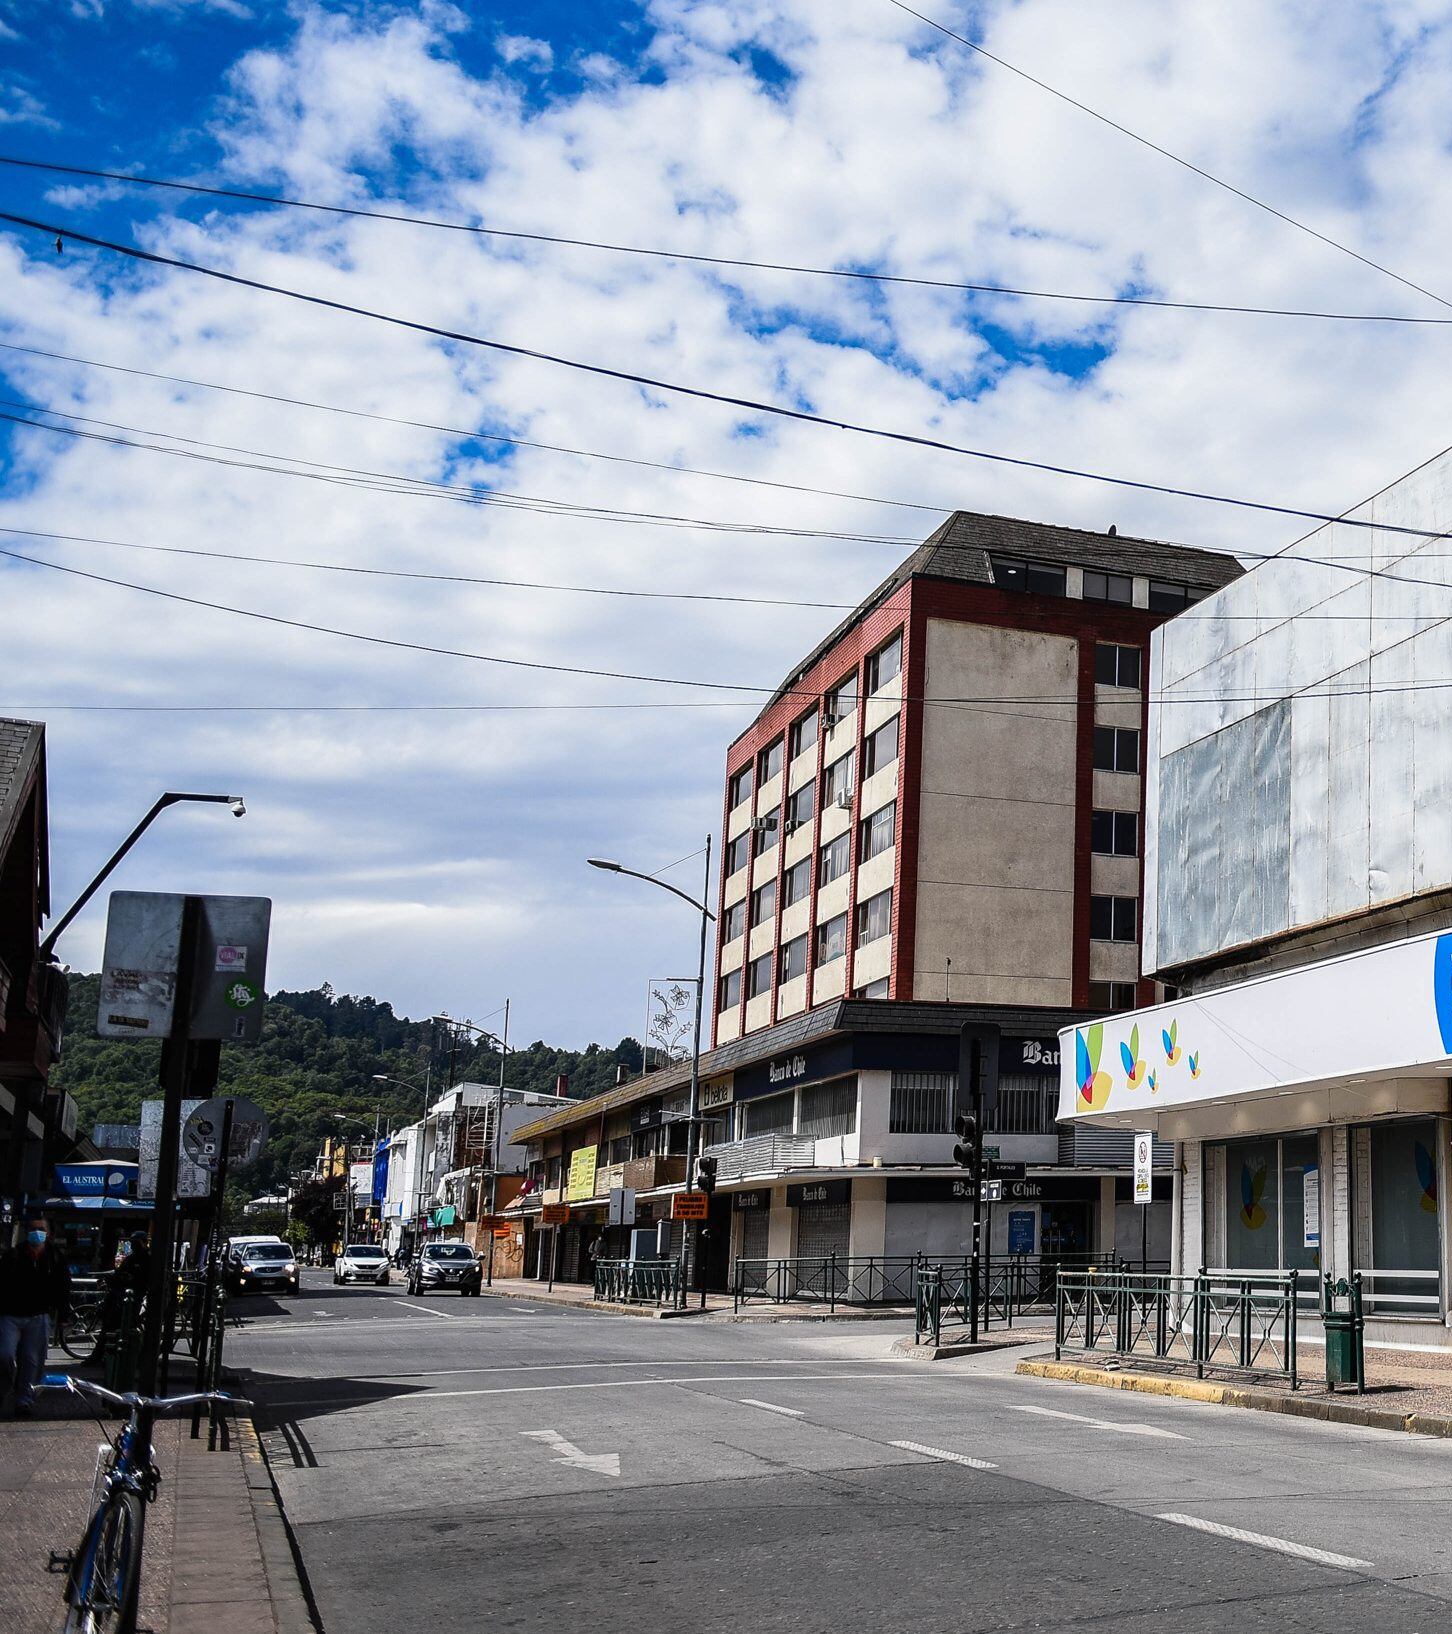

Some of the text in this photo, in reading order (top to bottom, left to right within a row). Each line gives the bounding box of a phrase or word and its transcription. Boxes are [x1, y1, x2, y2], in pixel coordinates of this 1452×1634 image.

[1022, 1041, 1060, 1065] Ban
[62, 1176, 71, 1184] EL
[1012, 1182, 1042, 1197] Chile
